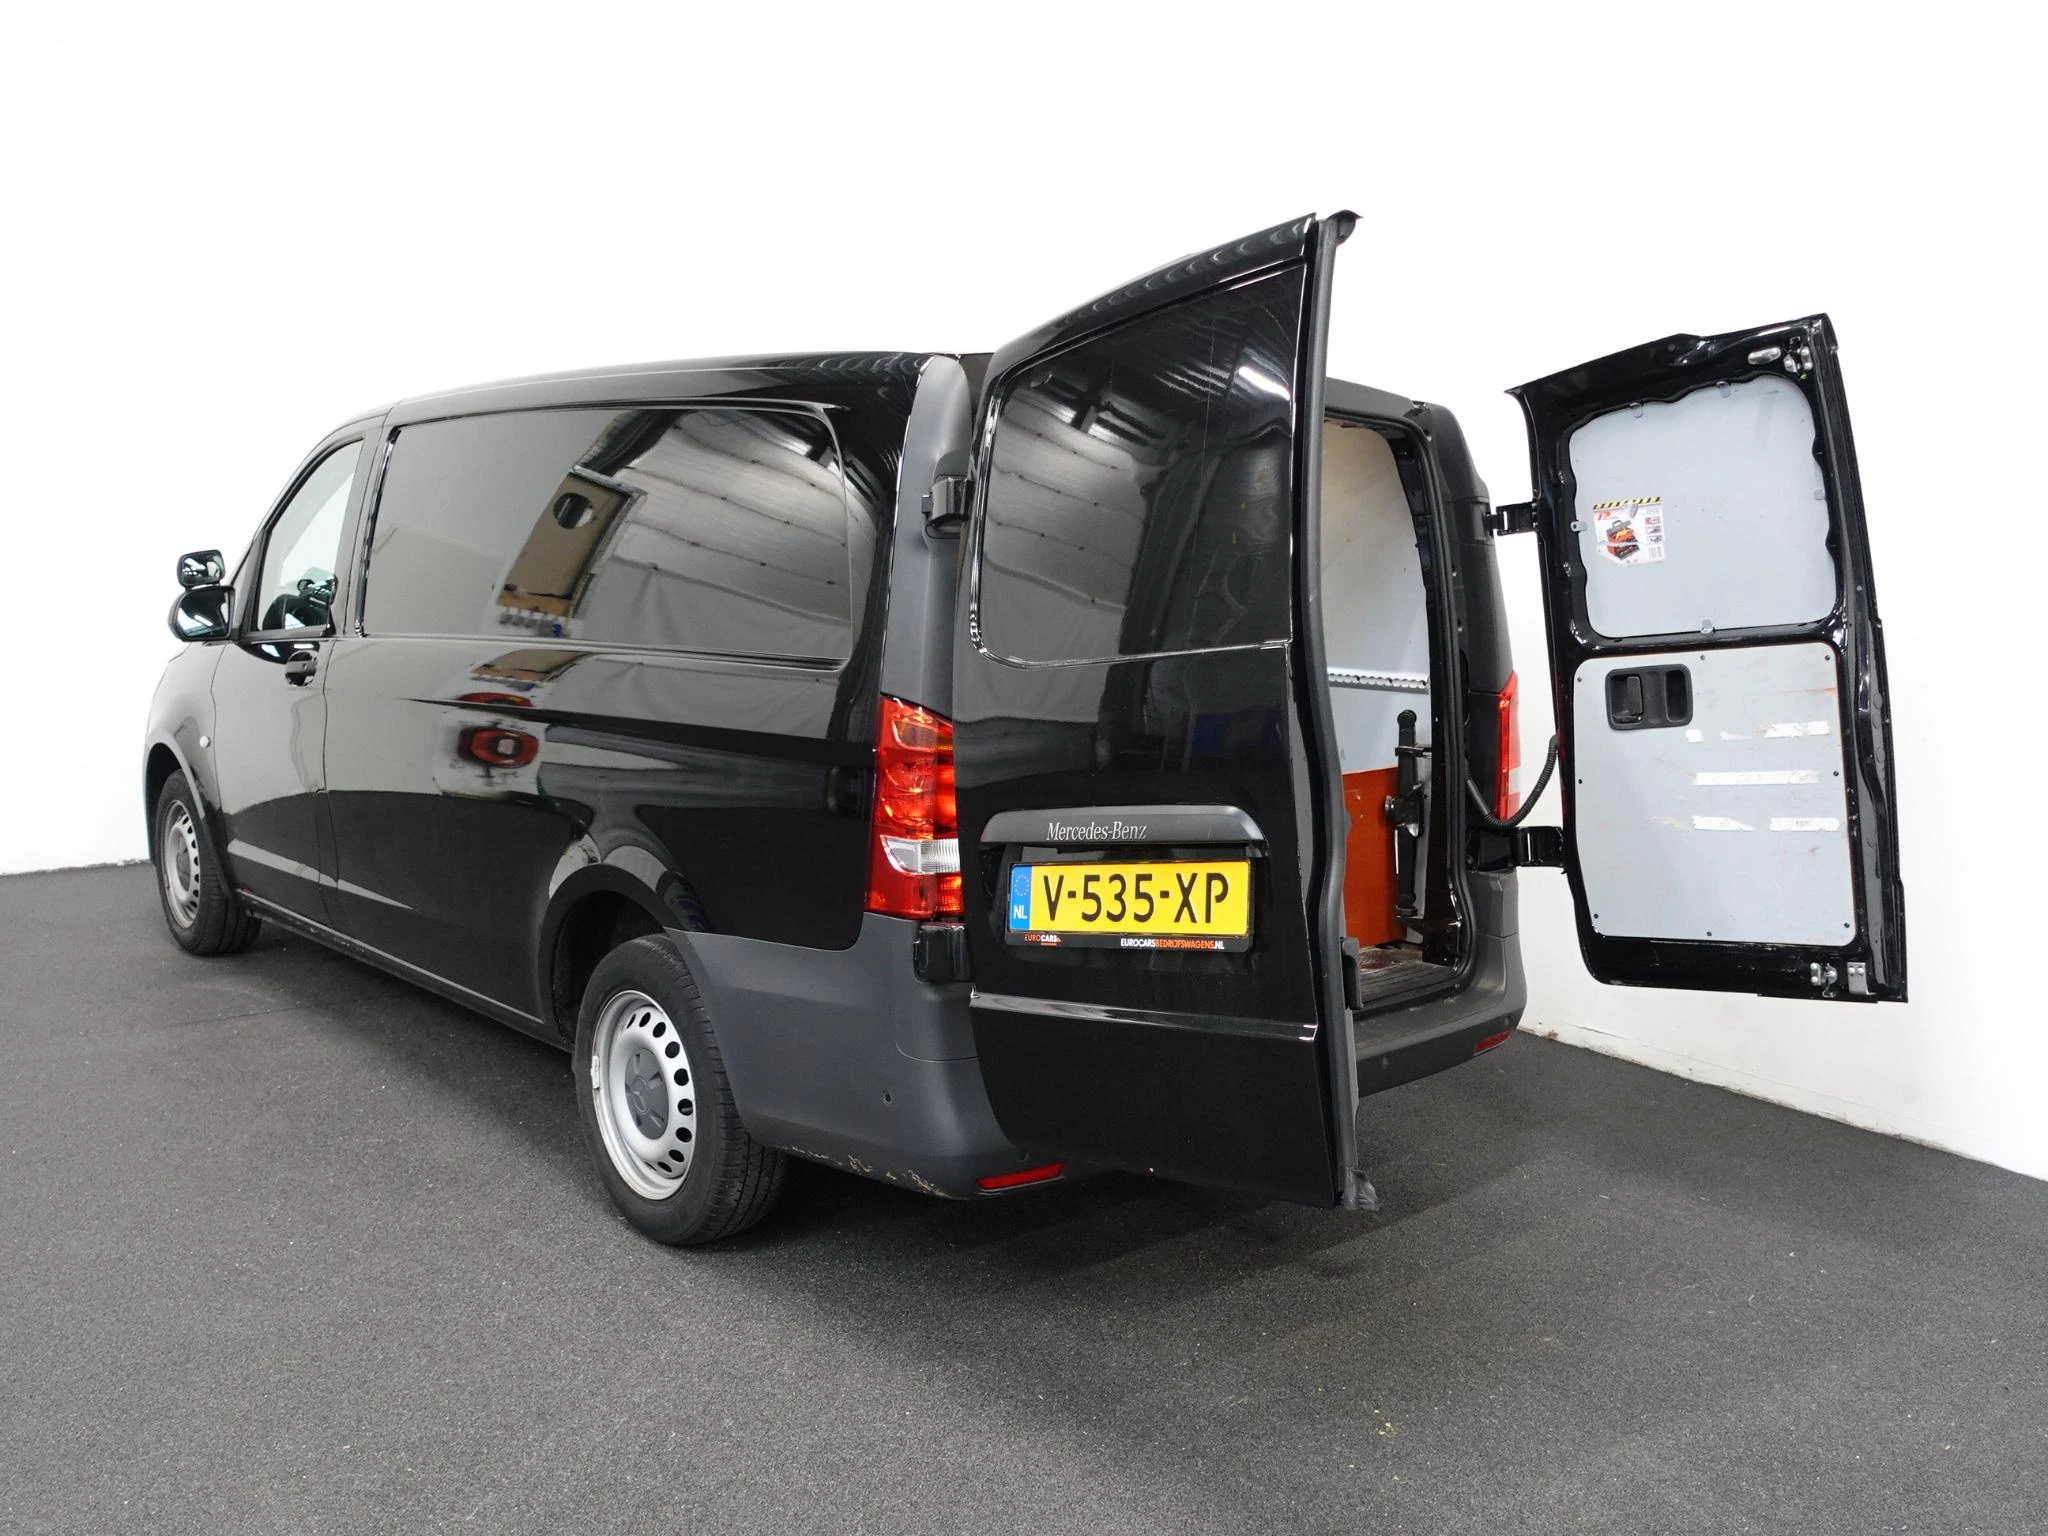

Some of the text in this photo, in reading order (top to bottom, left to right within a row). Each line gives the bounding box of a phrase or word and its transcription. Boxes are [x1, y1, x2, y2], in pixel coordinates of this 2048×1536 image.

[1047, 821, 1149, 841] Mercedes-Benz
[1043, 872, 1229, 923] V-535-XP
[1013, 905, 1028, 920] NL
[1024, 933, 1058, 943] EUROCARS
